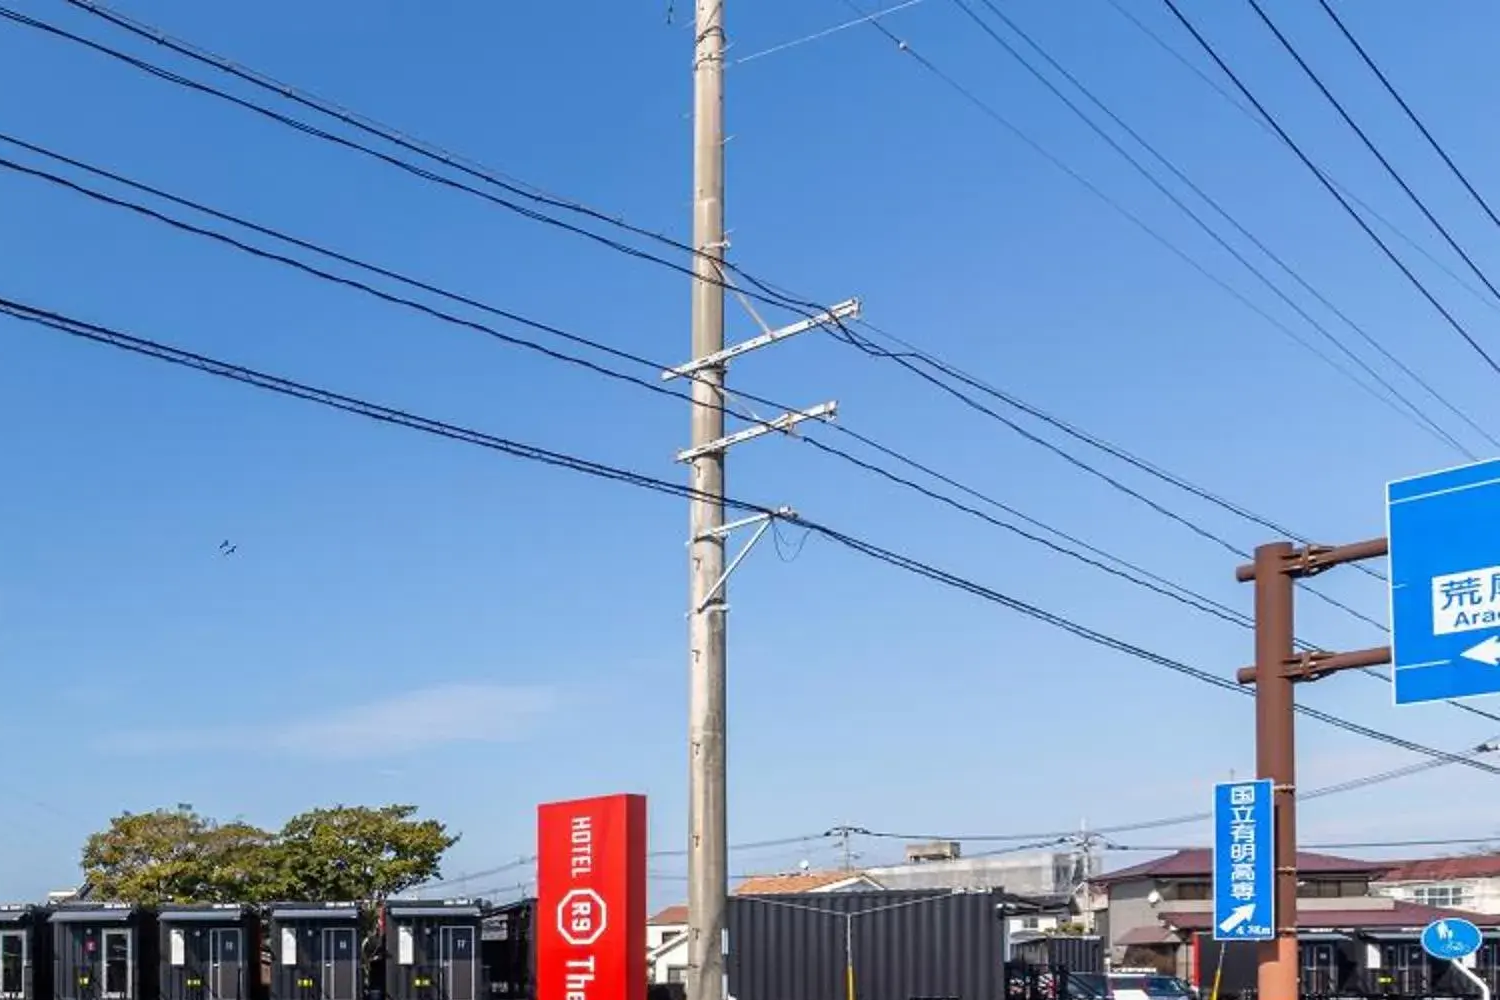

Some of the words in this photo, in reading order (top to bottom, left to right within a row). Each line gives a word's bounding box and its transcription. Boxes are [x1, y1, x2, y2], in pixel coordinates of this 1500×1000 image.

[1454, 609, 1500, 628] Ara
[571, 816, 592, 878] HOTEL
[1231, 785, 1256, 900] 国立有明高専
[571, 901, 591, 931] R9
